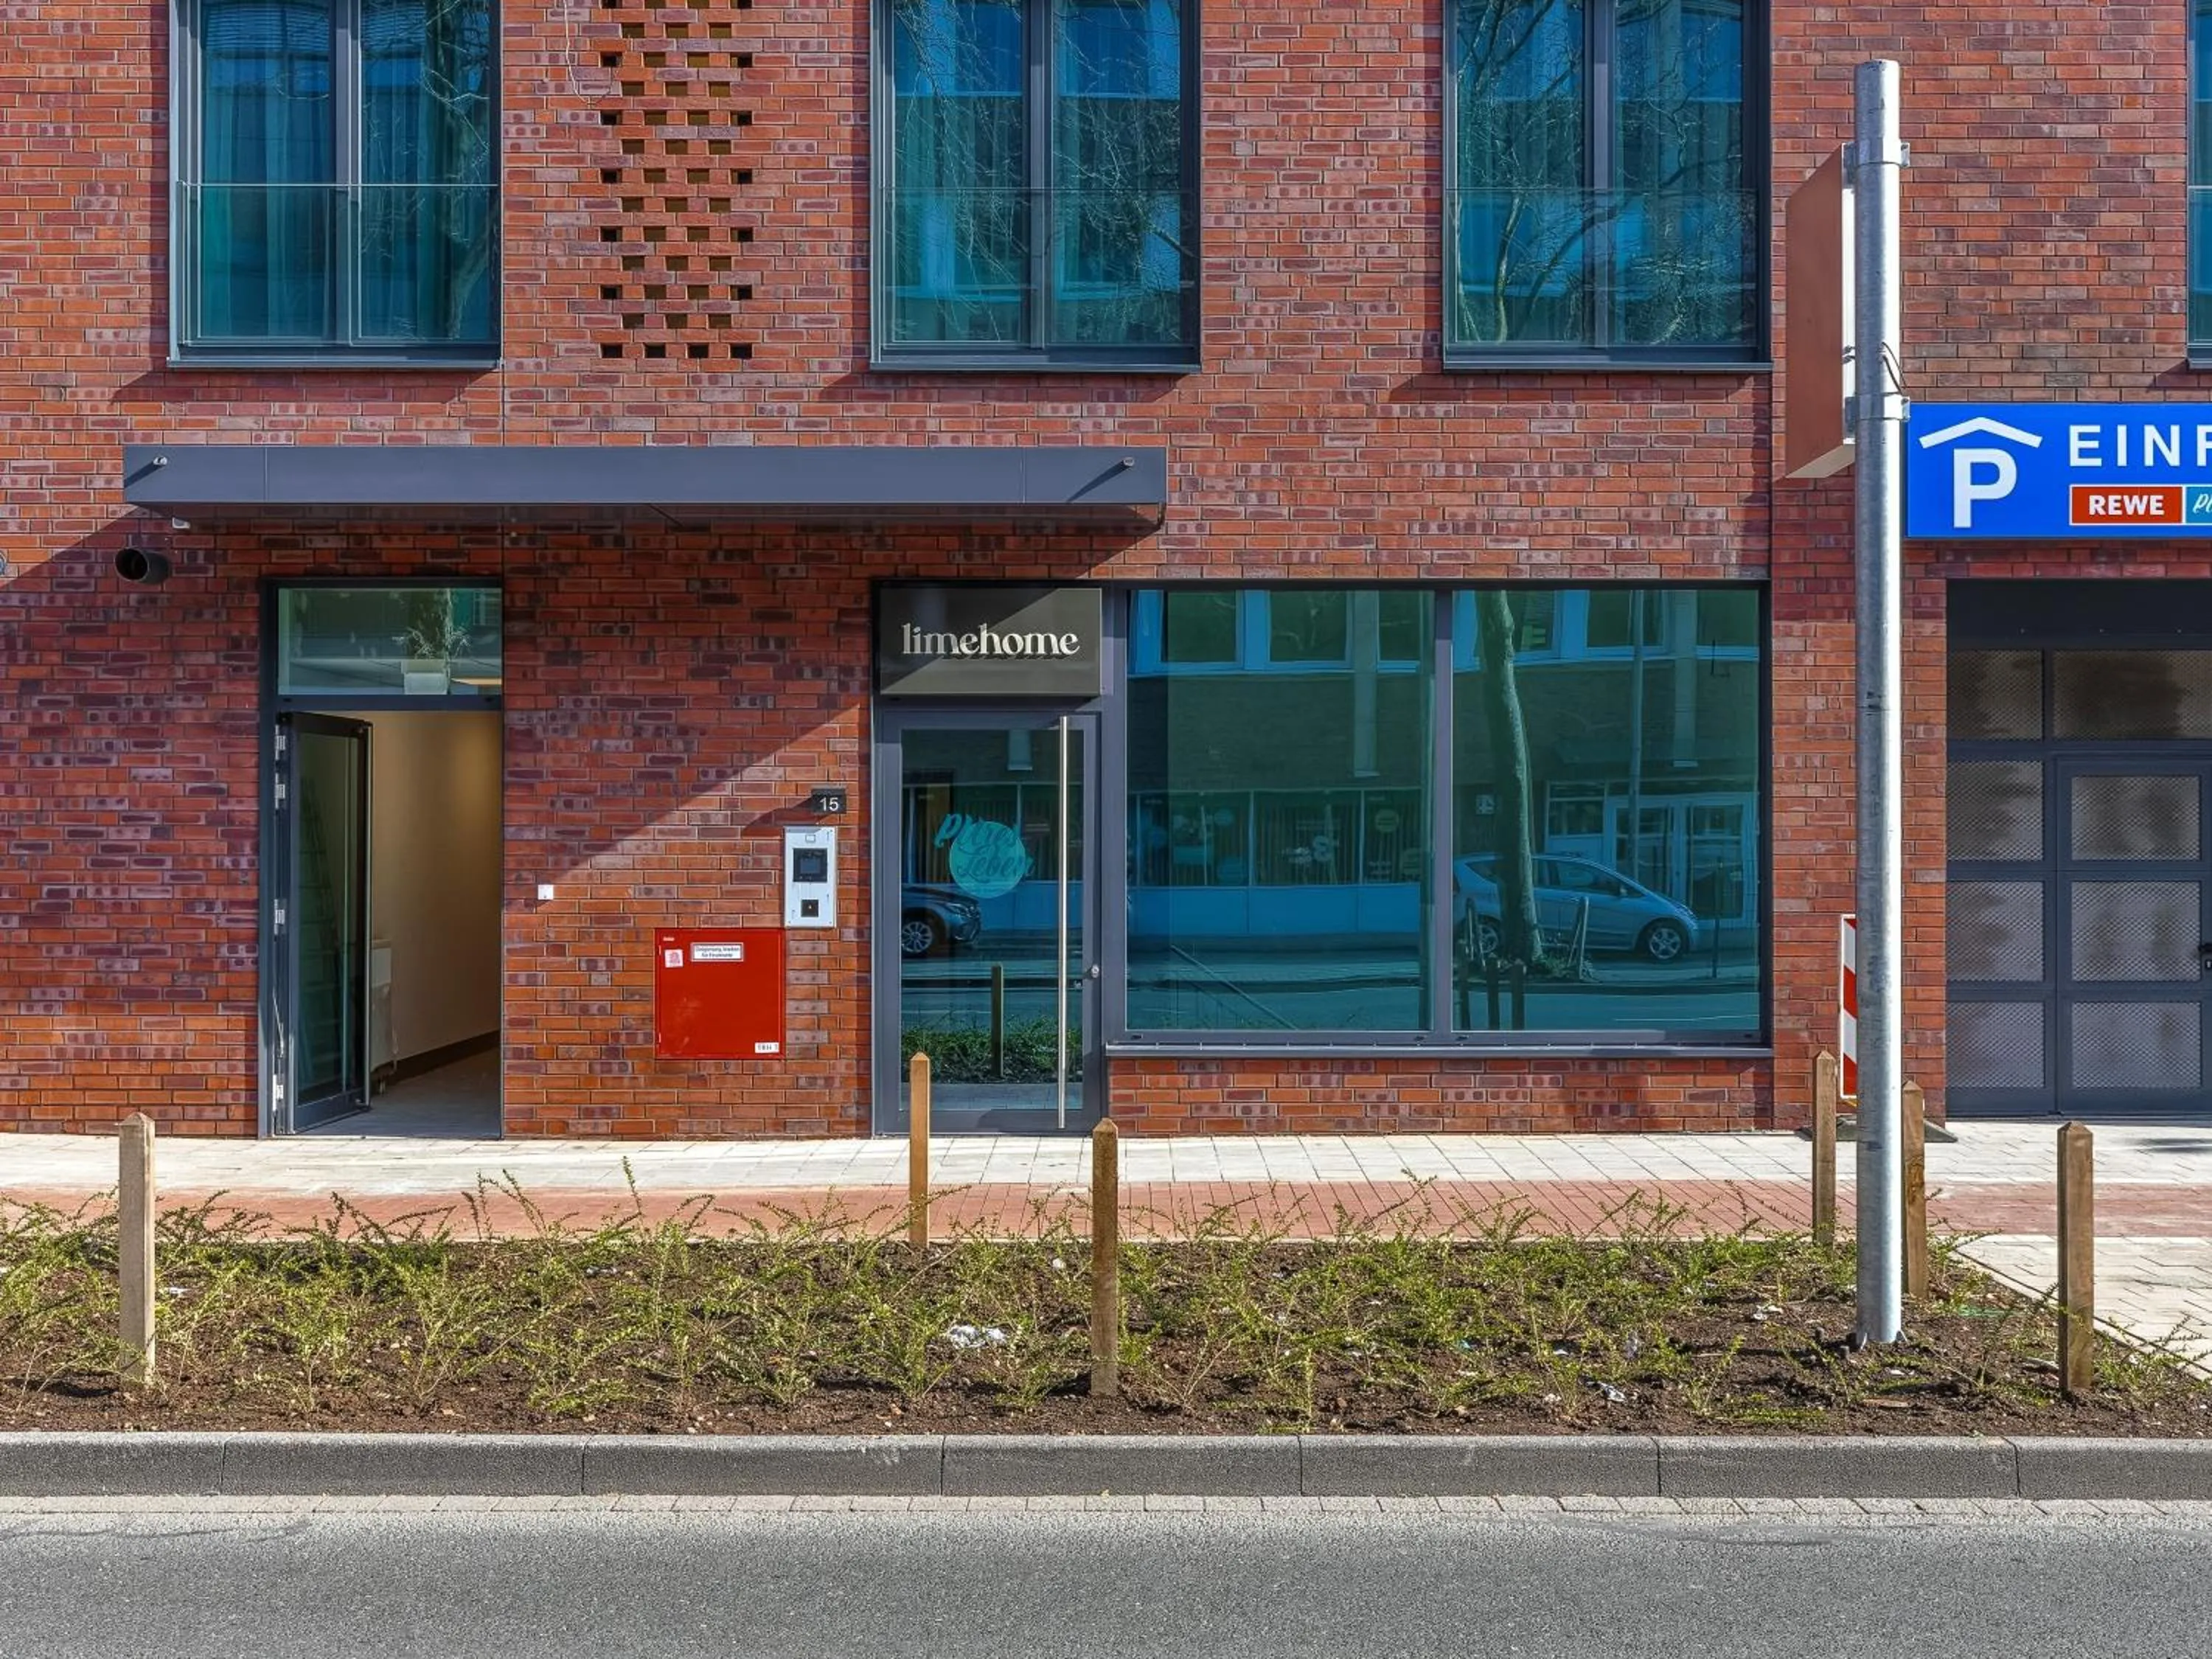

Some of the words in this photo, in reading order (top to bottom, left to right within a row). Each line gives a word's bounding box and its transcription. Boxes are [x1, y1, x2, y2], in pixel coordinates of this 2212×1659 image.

[1953, 448, 2017, 529] P
[2088, 494, 2165, 515] REWE
[901, 622, 1081, 655] limehome
[819, 796, 838, 812] 15
